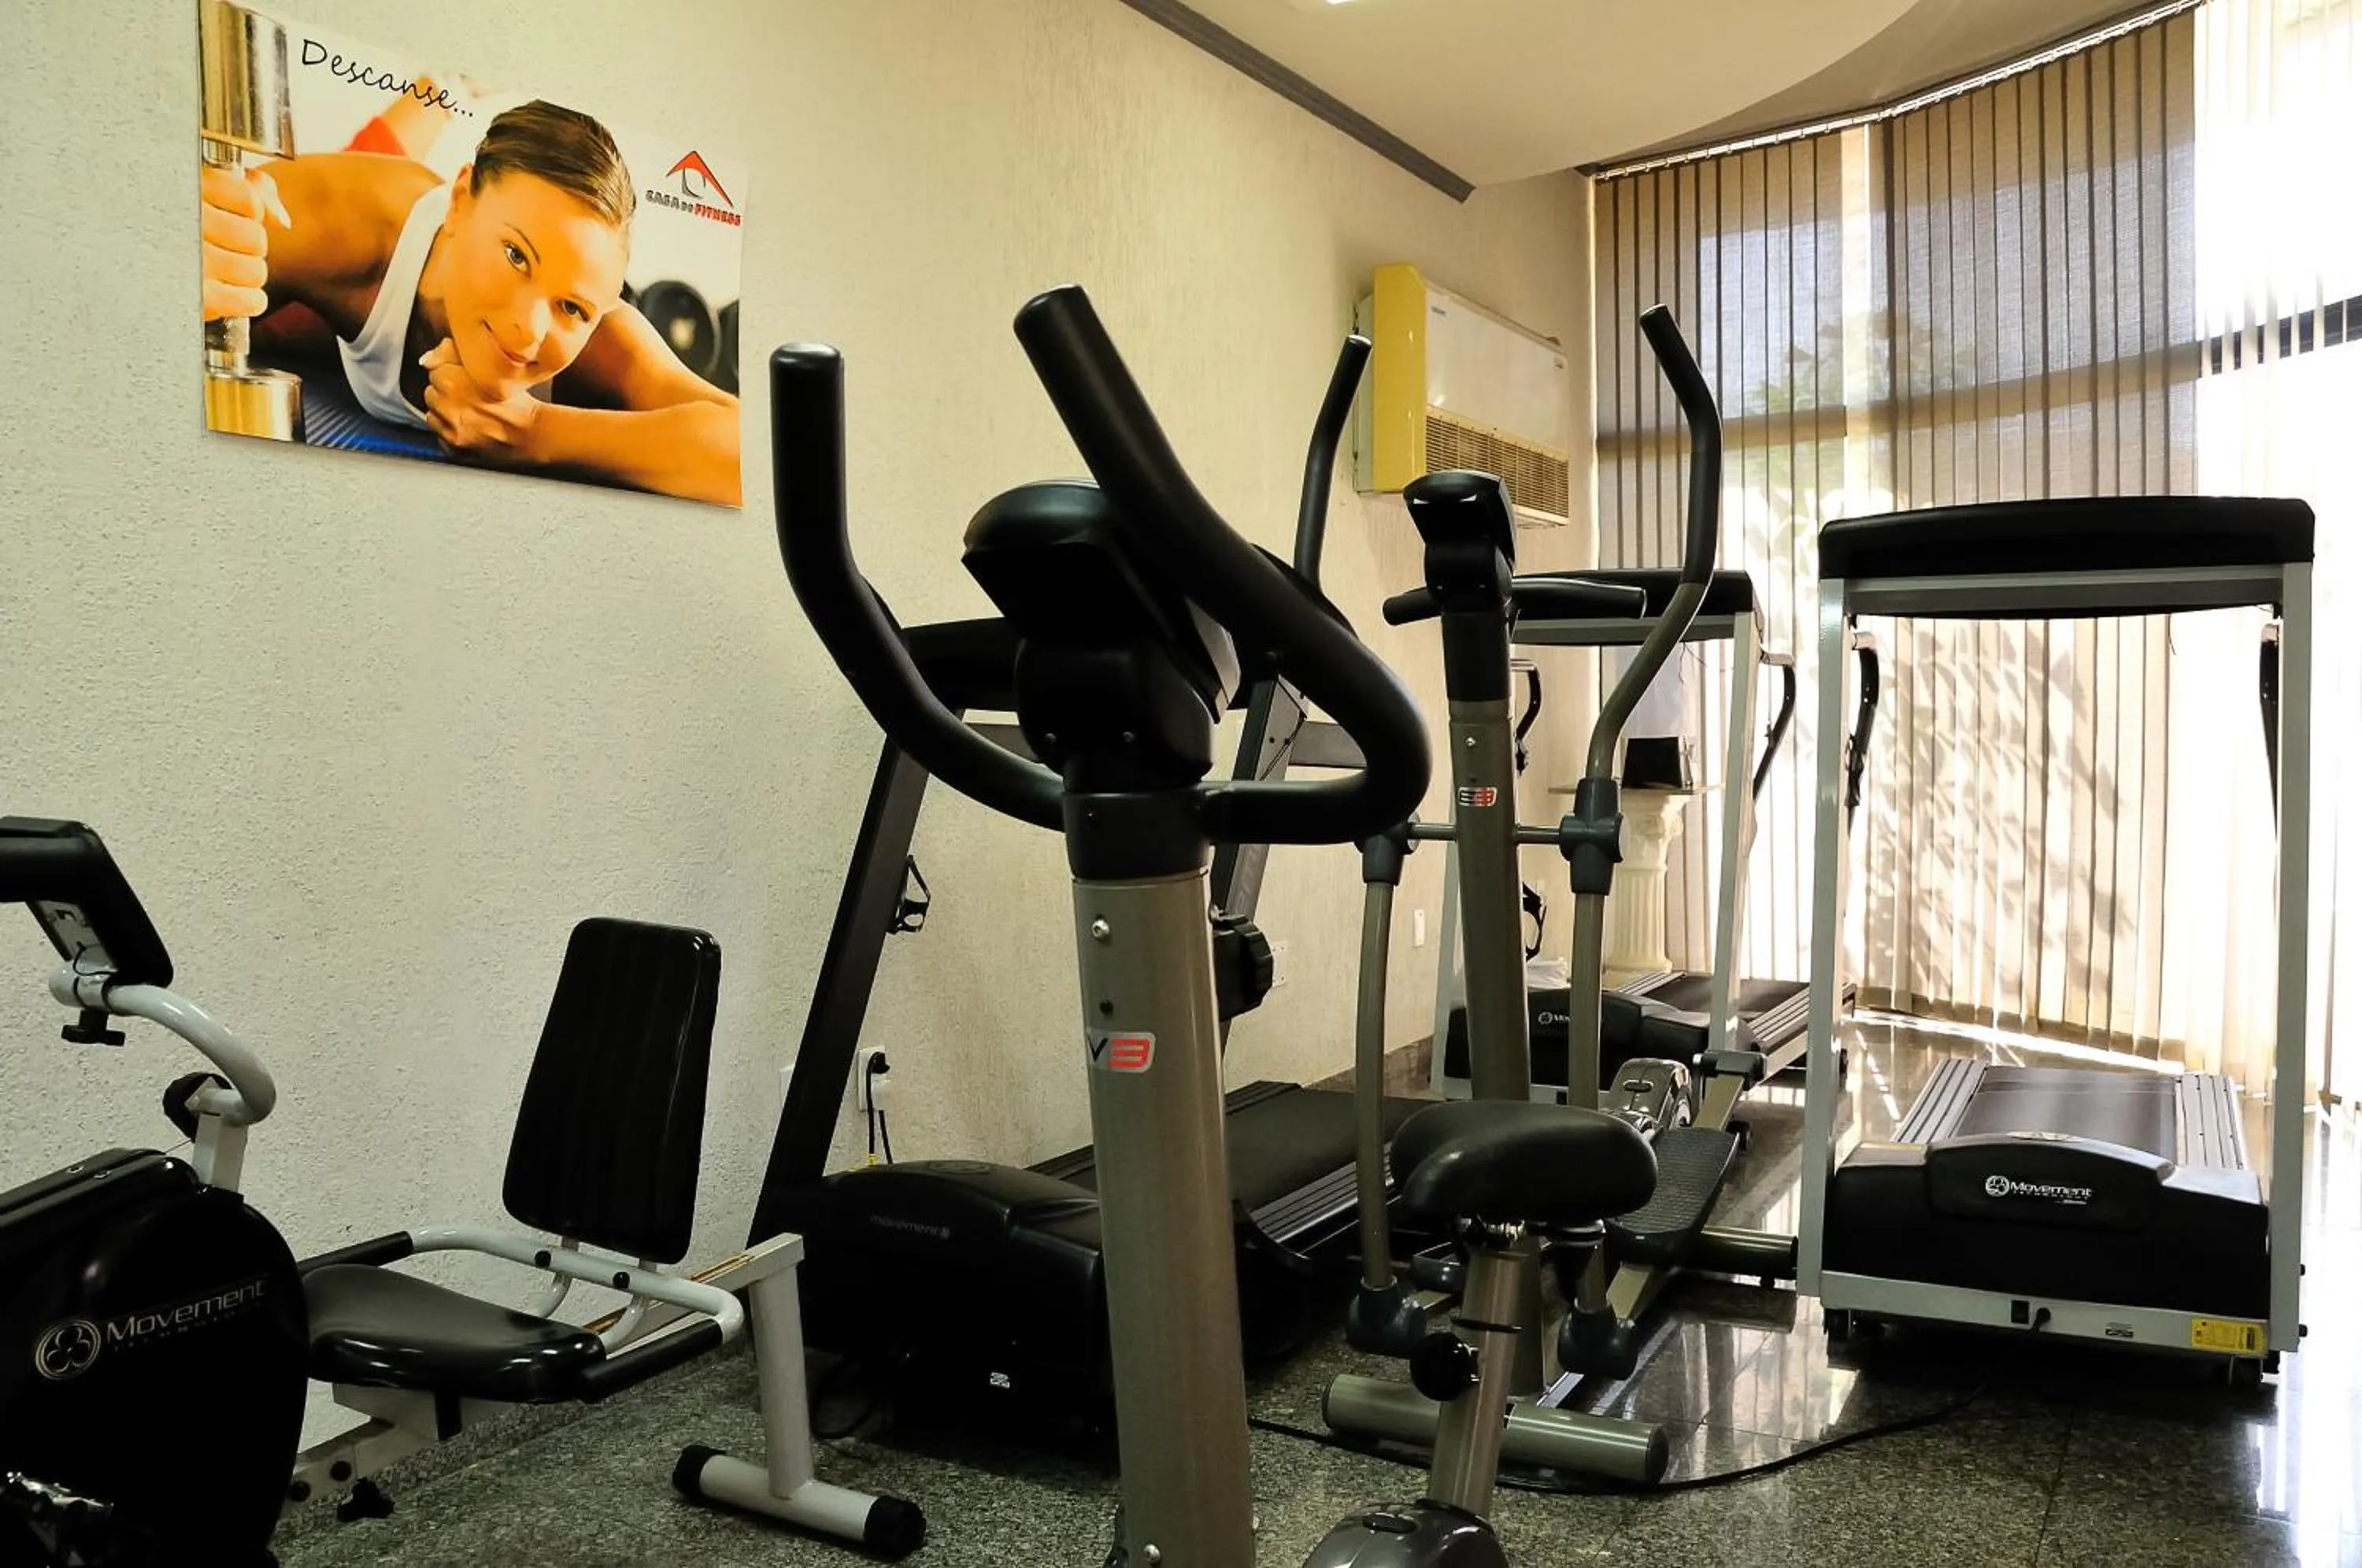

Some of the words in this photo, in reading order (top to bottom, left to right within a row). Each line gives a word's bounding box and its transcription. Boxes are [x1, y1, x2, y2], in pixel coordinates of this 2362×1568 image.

[302, 39, 474, 118] Descanse...
[646, 190, 679, 210] CASA
[694, 203, 741, 227] FITNESS
[1087, 1032, 1150, 1068] V3
[2010, 1182, 2093, 1197] Movement
[106, 1279, 268, 1344] Movement
